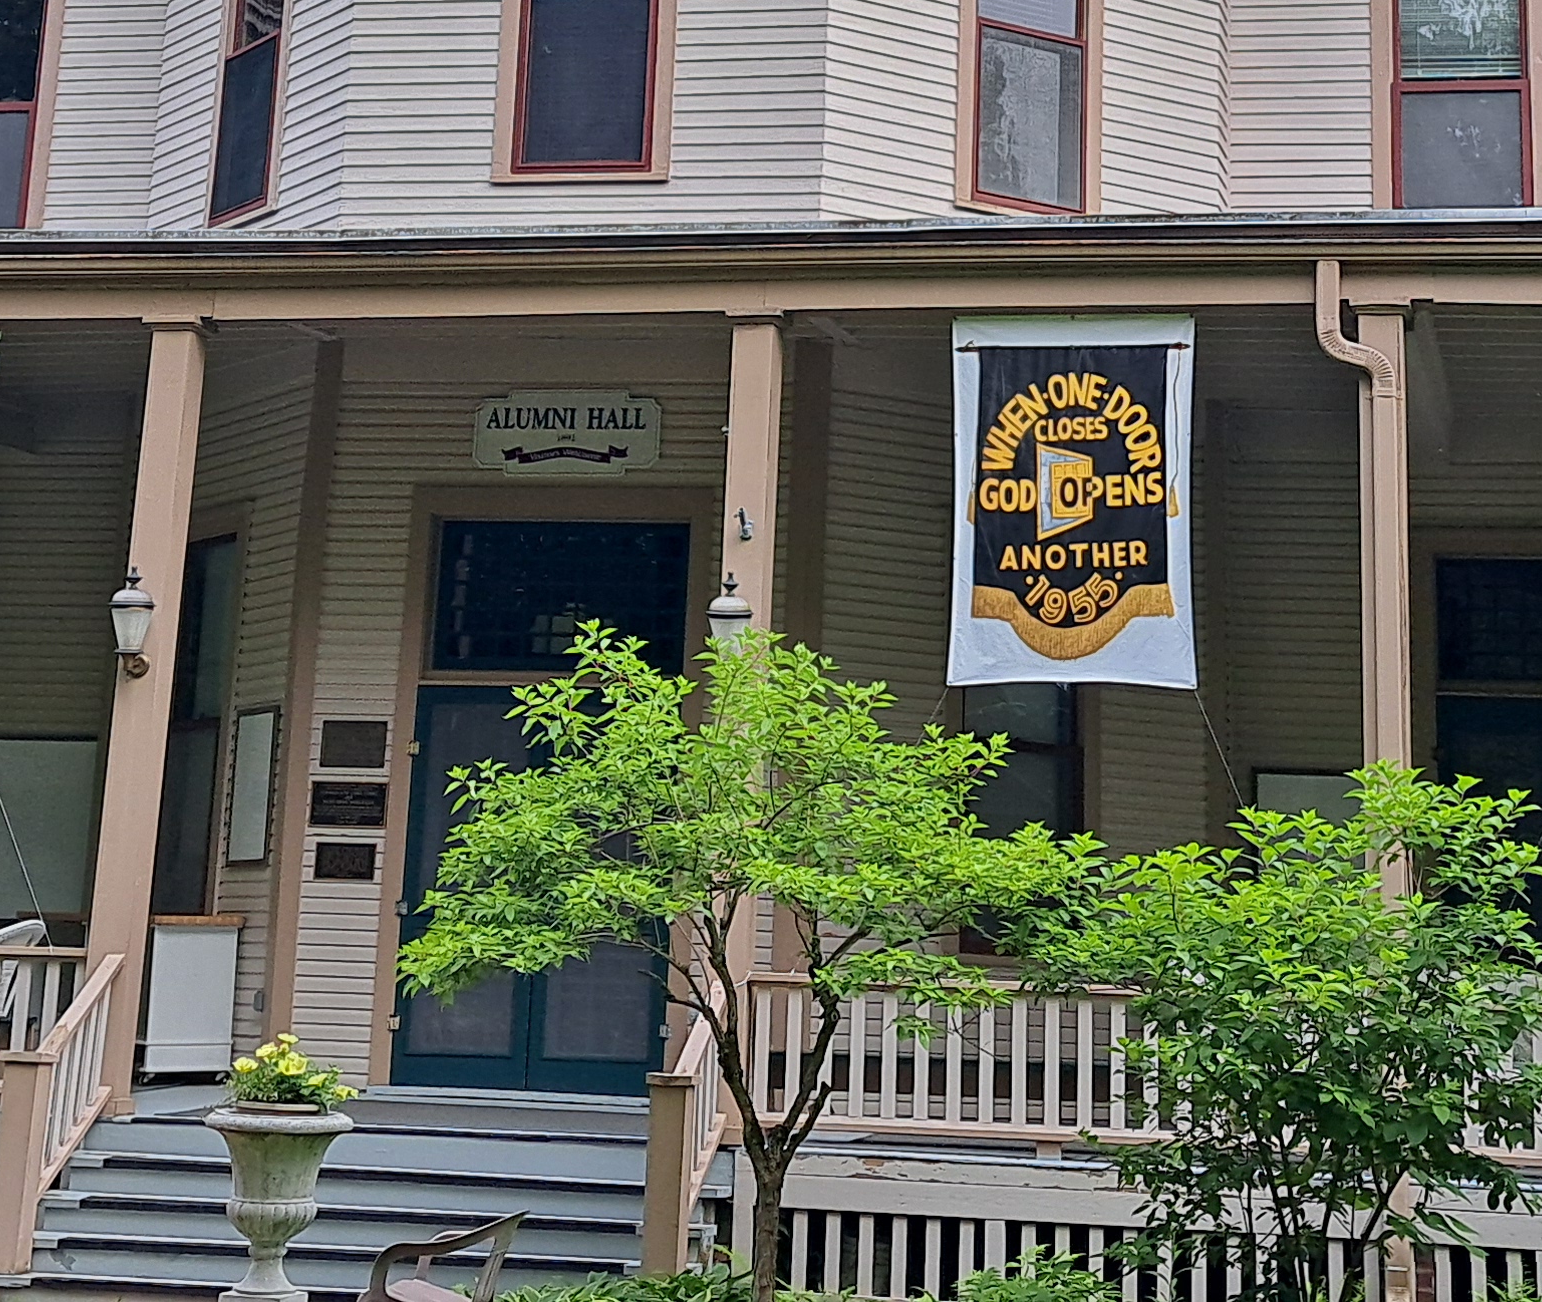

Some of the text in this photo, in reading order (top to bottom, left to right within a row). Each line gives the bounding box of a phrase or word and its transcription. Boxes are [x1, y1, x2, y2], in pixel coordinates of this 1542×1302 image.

[486, 407, 646, 430] ALUMNI HALL
[981, 372, 1162, 474] WHEN ONE DOOR
[1034, 416, 1108, 441] CLOSES
[979, 472, 1164, 512] GOD OPENS
[999, 541, 1148, 570] ANOTHER
[1025, 572, 1119, 624] 1955
